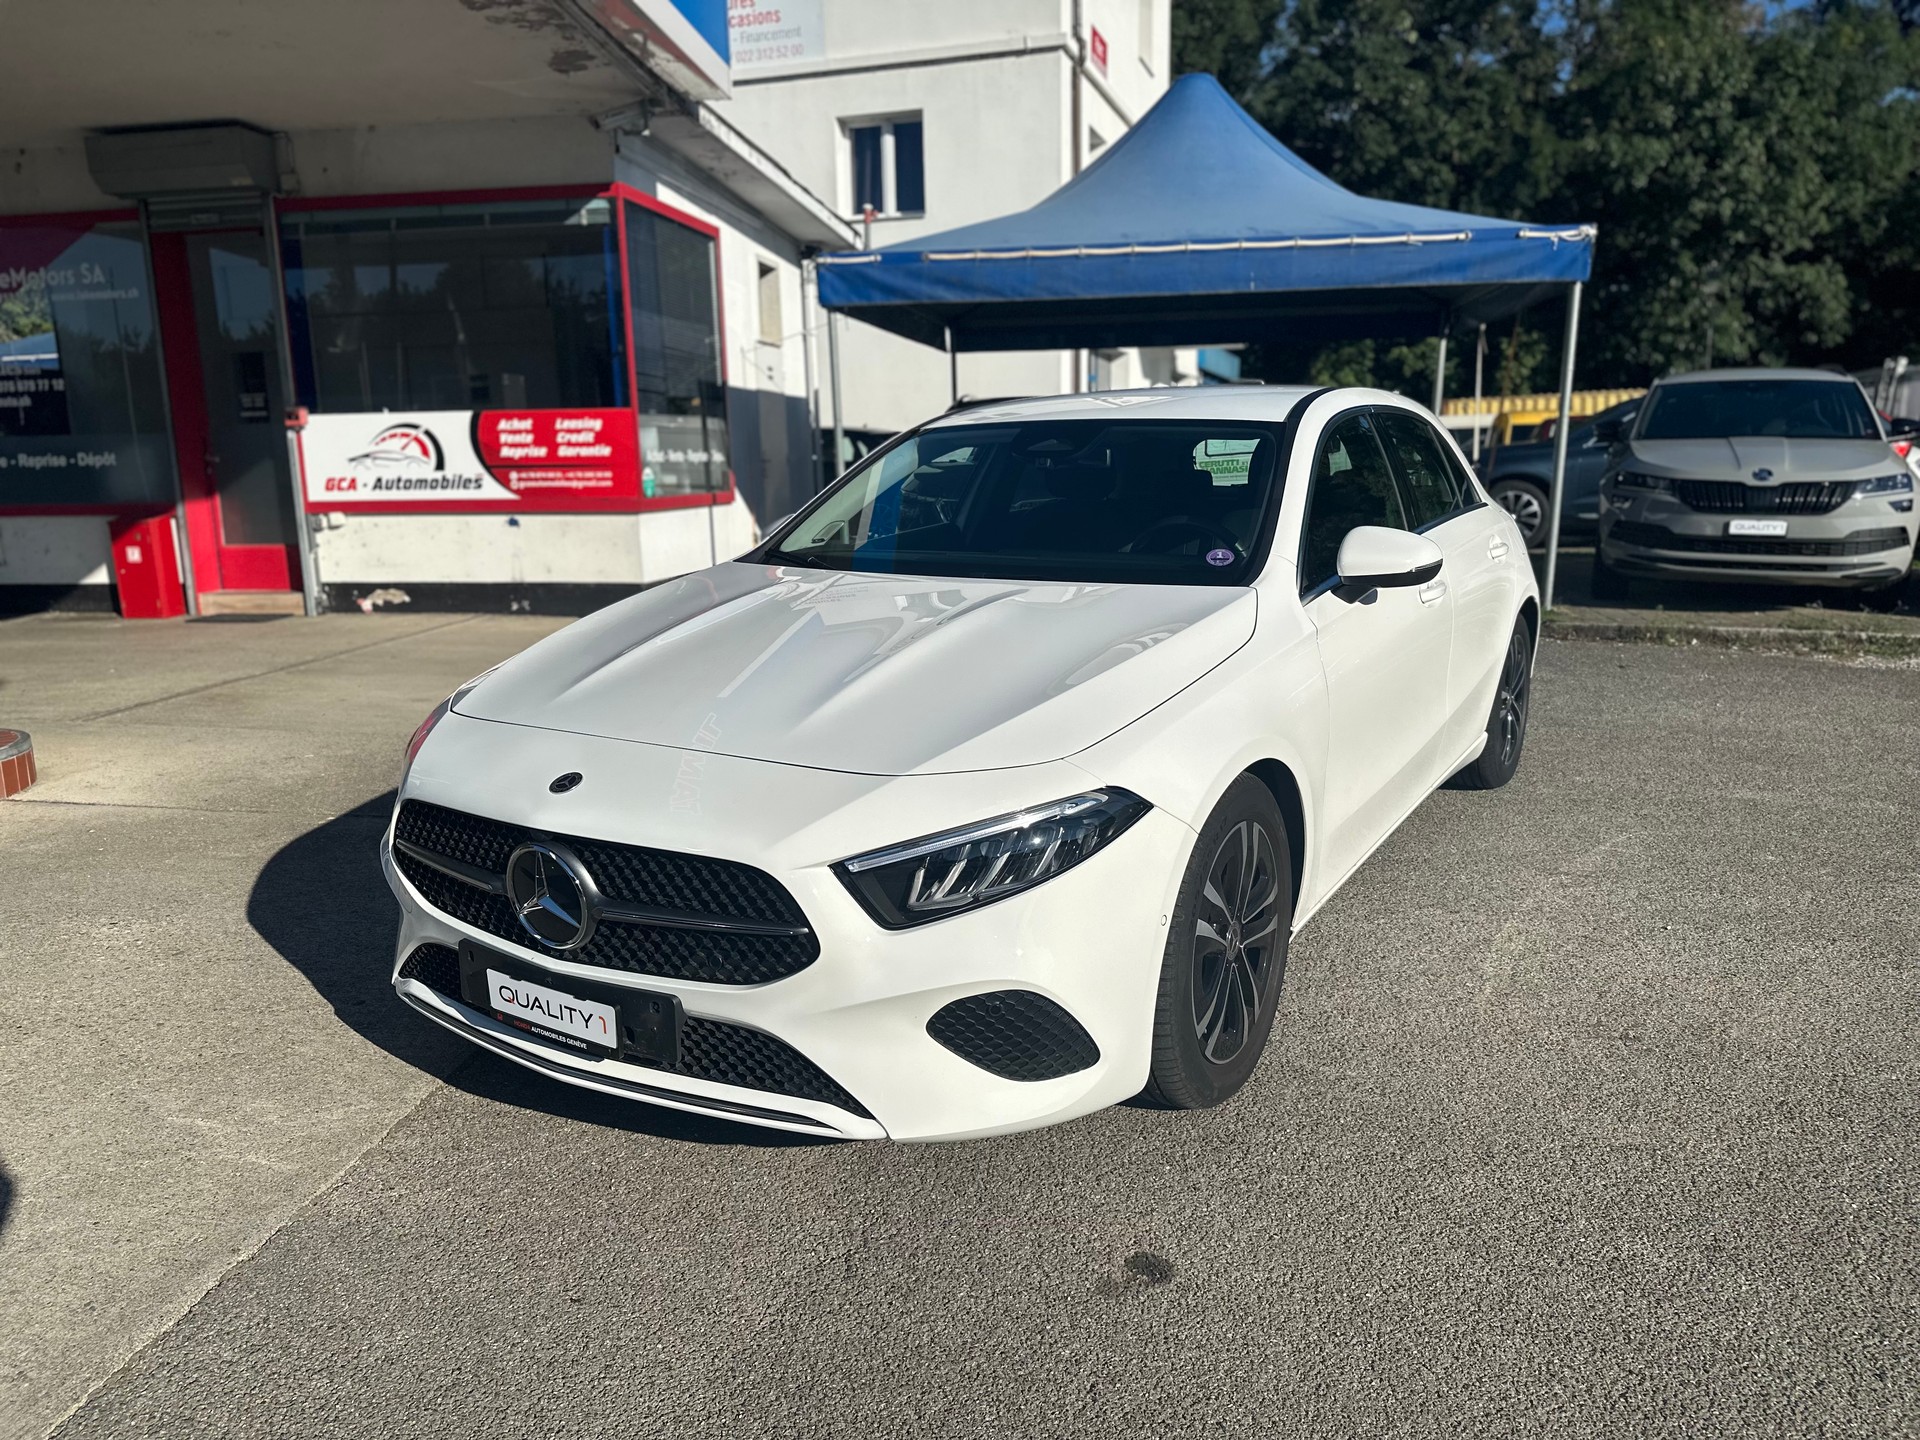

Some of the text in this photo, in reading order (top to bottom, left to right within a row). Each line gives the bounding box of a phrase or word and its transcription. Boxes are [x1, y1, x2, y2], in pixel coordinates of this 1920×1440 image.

[80, 263, 106, 285] SA
[554, 416, 603, 433] Leasing
[18, 452, 68, 471] Reprise
[1199, 459, 1240, 468] CERUTTI
[325, 476, 357, 491] GCA
[372, 474, 483, 491] Automobiles
[499, 985, 609, 1035] QUALITY 1
[531, 1026, 567, 1044] AUTOMOBILES
[566, 1038, 588, 1050] GENÈVE
